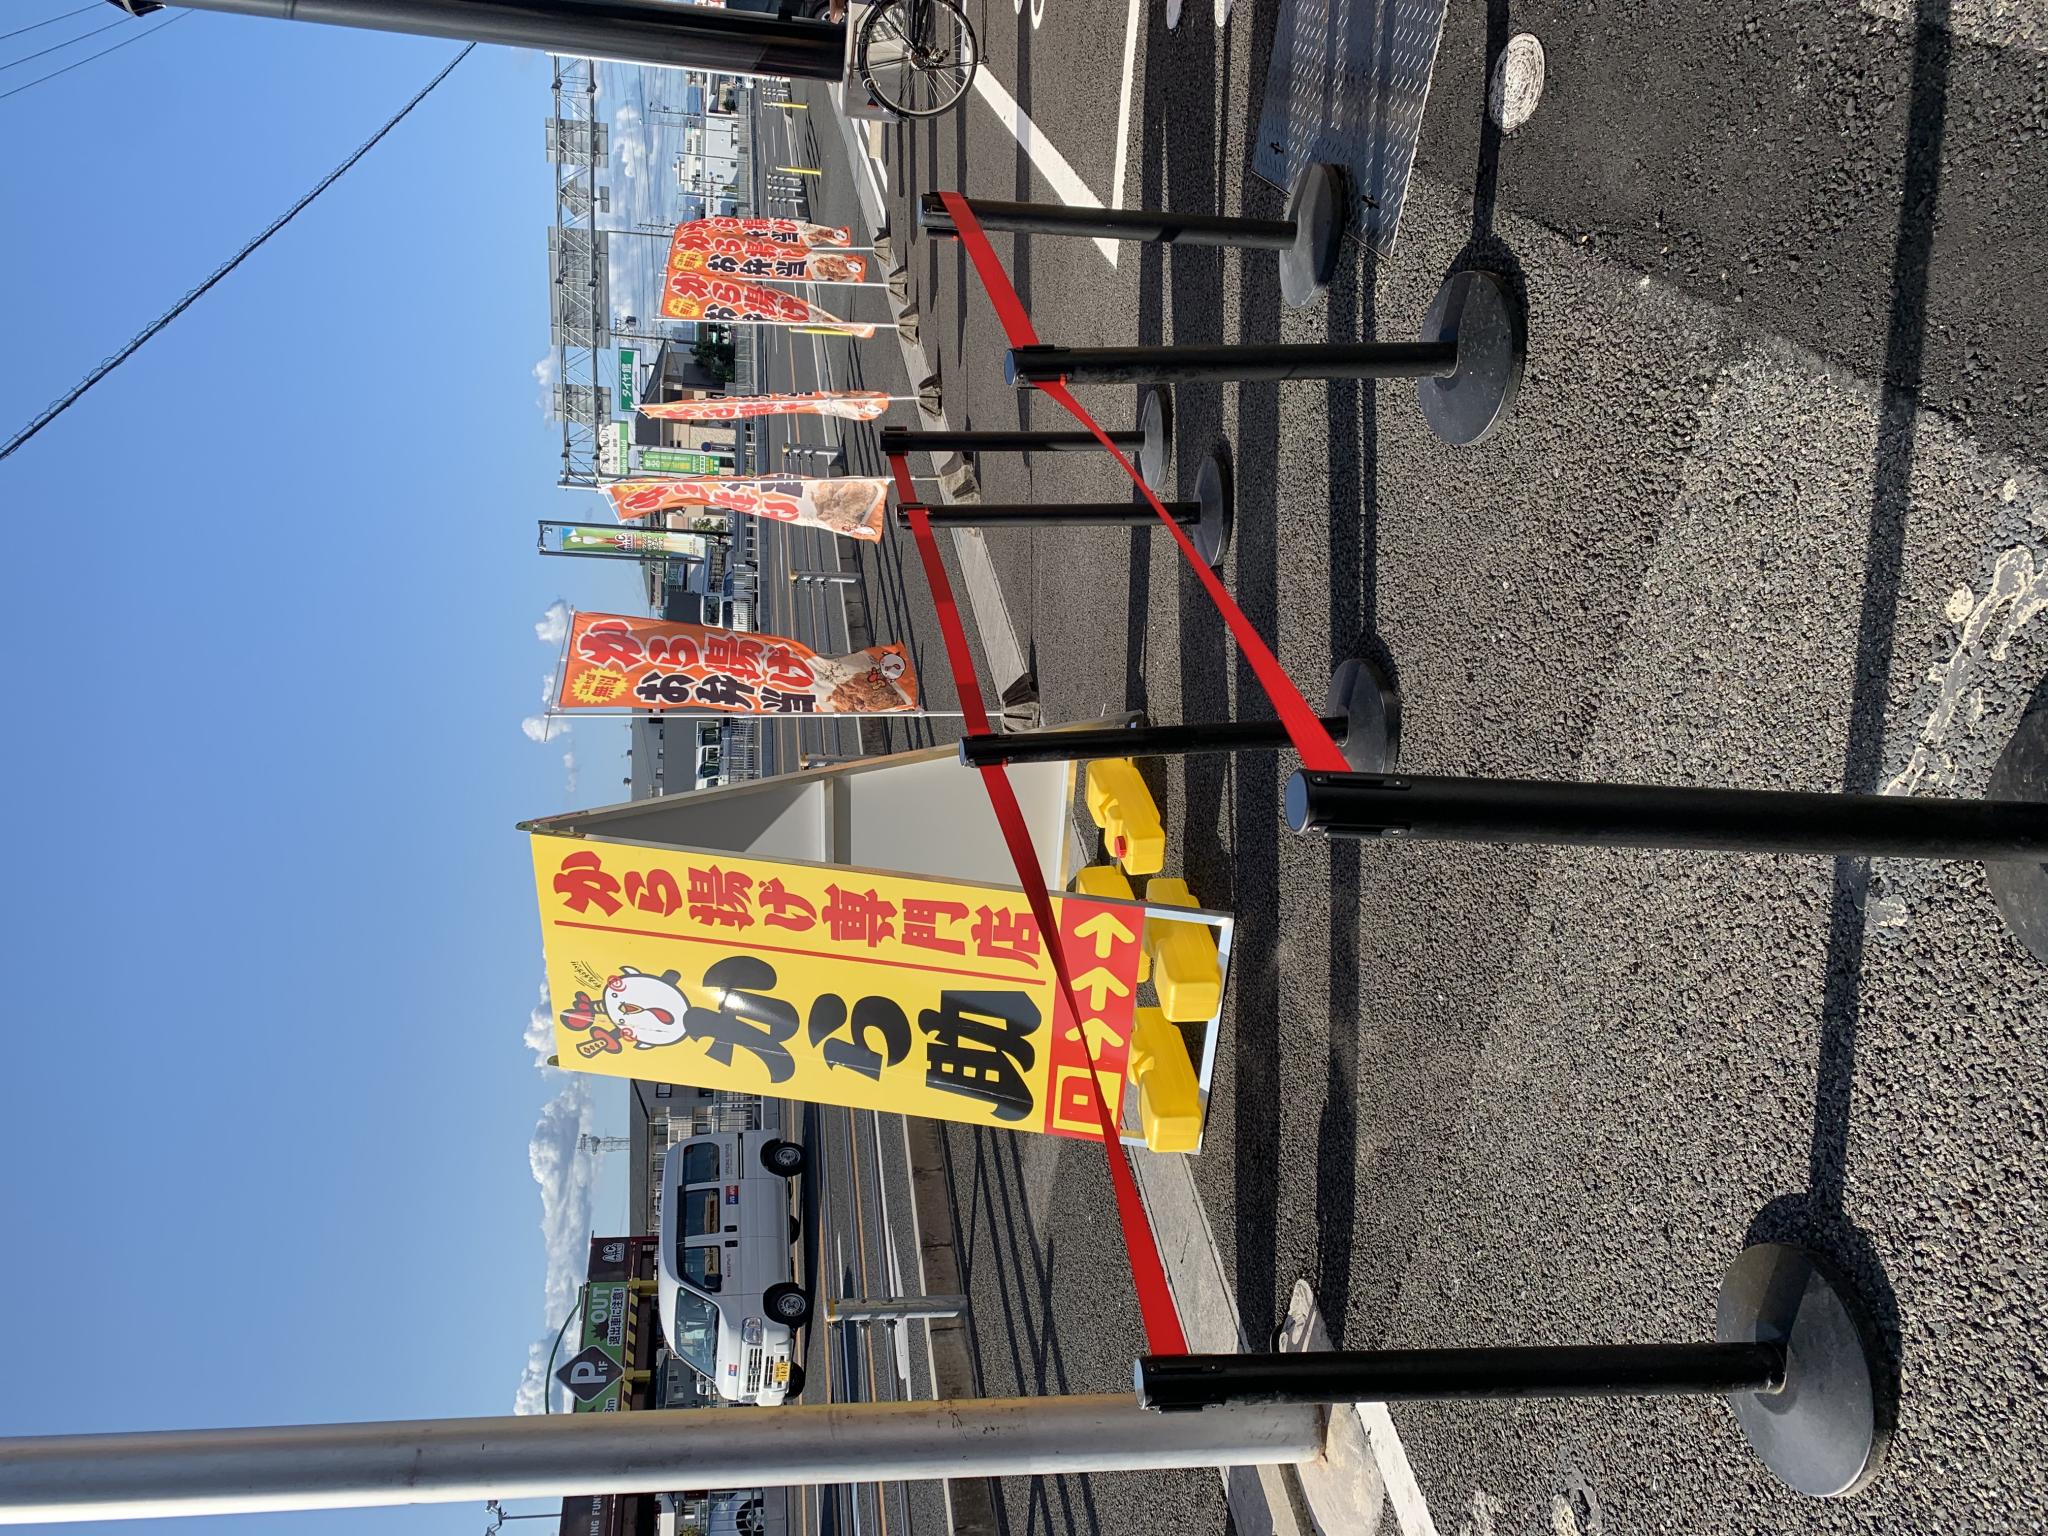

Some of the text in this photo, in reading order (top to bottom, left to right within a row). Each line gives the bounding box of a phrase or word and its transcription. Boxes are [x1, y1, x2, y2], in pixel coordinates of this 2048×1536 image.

[706, 253, 808, 278] お弁当
[671, 271, 809, 321] から揚げ
[621, 363, 632, 397] タイヤ館
[577, 618, 815, 688] から揚げ
[553, 851, 1040, 969] から揚げ専門店
[682, 956, 1041, 1122] から助
[590, 1286, 610, 1323] OUT
[570, 1361, 607, 1384] P
[597, 1360, 608, 1373] 1F
[591, 1494, 602, 1516] FUN
